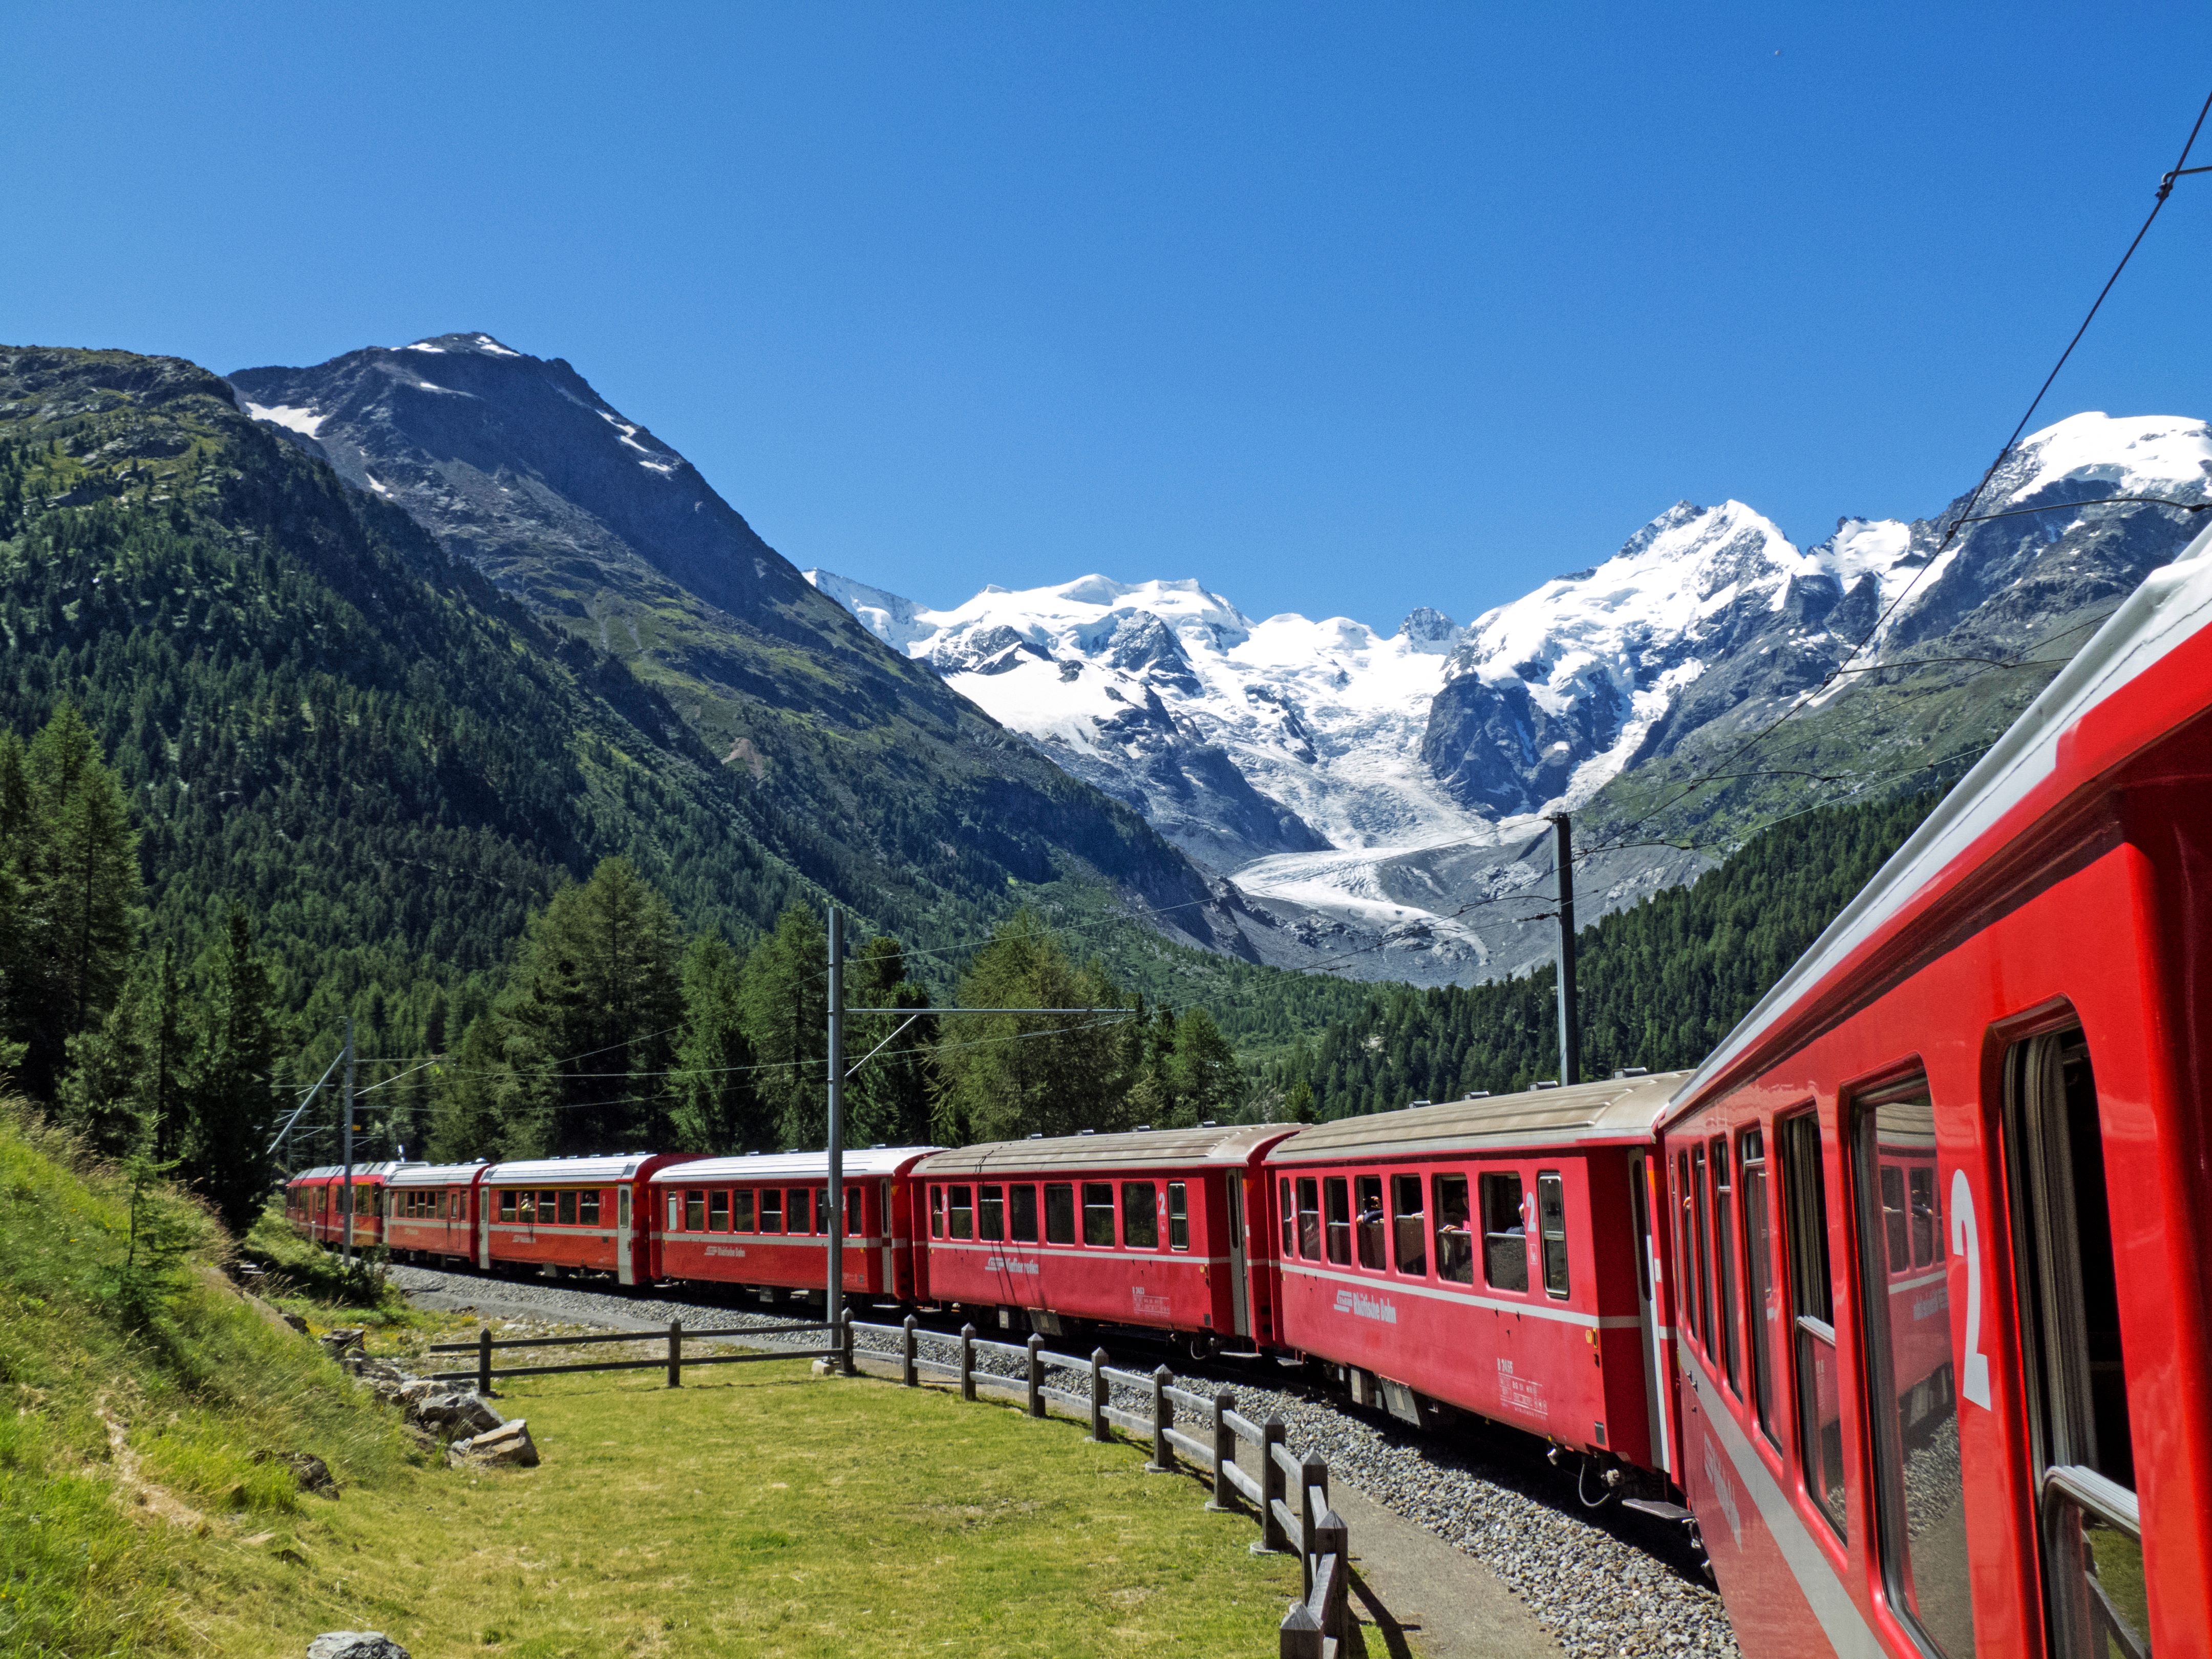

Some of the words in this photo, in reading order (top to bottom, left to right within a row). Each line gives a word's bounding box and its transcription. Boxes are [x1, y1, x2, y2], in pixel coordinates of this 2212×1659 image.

[943, 1194, 948, 1211] 2
[1158, 1193, 1166, 1215] 2
[1291, 1192, 1296, 1217] 2
[1526, 1192, 1537, 1231] 2
[1951, 1169, 1991, 1412] 2
[1353, 1291, 1380, 1320] Rhätische
[1380, 1297, 1397, 1324] Bahn
